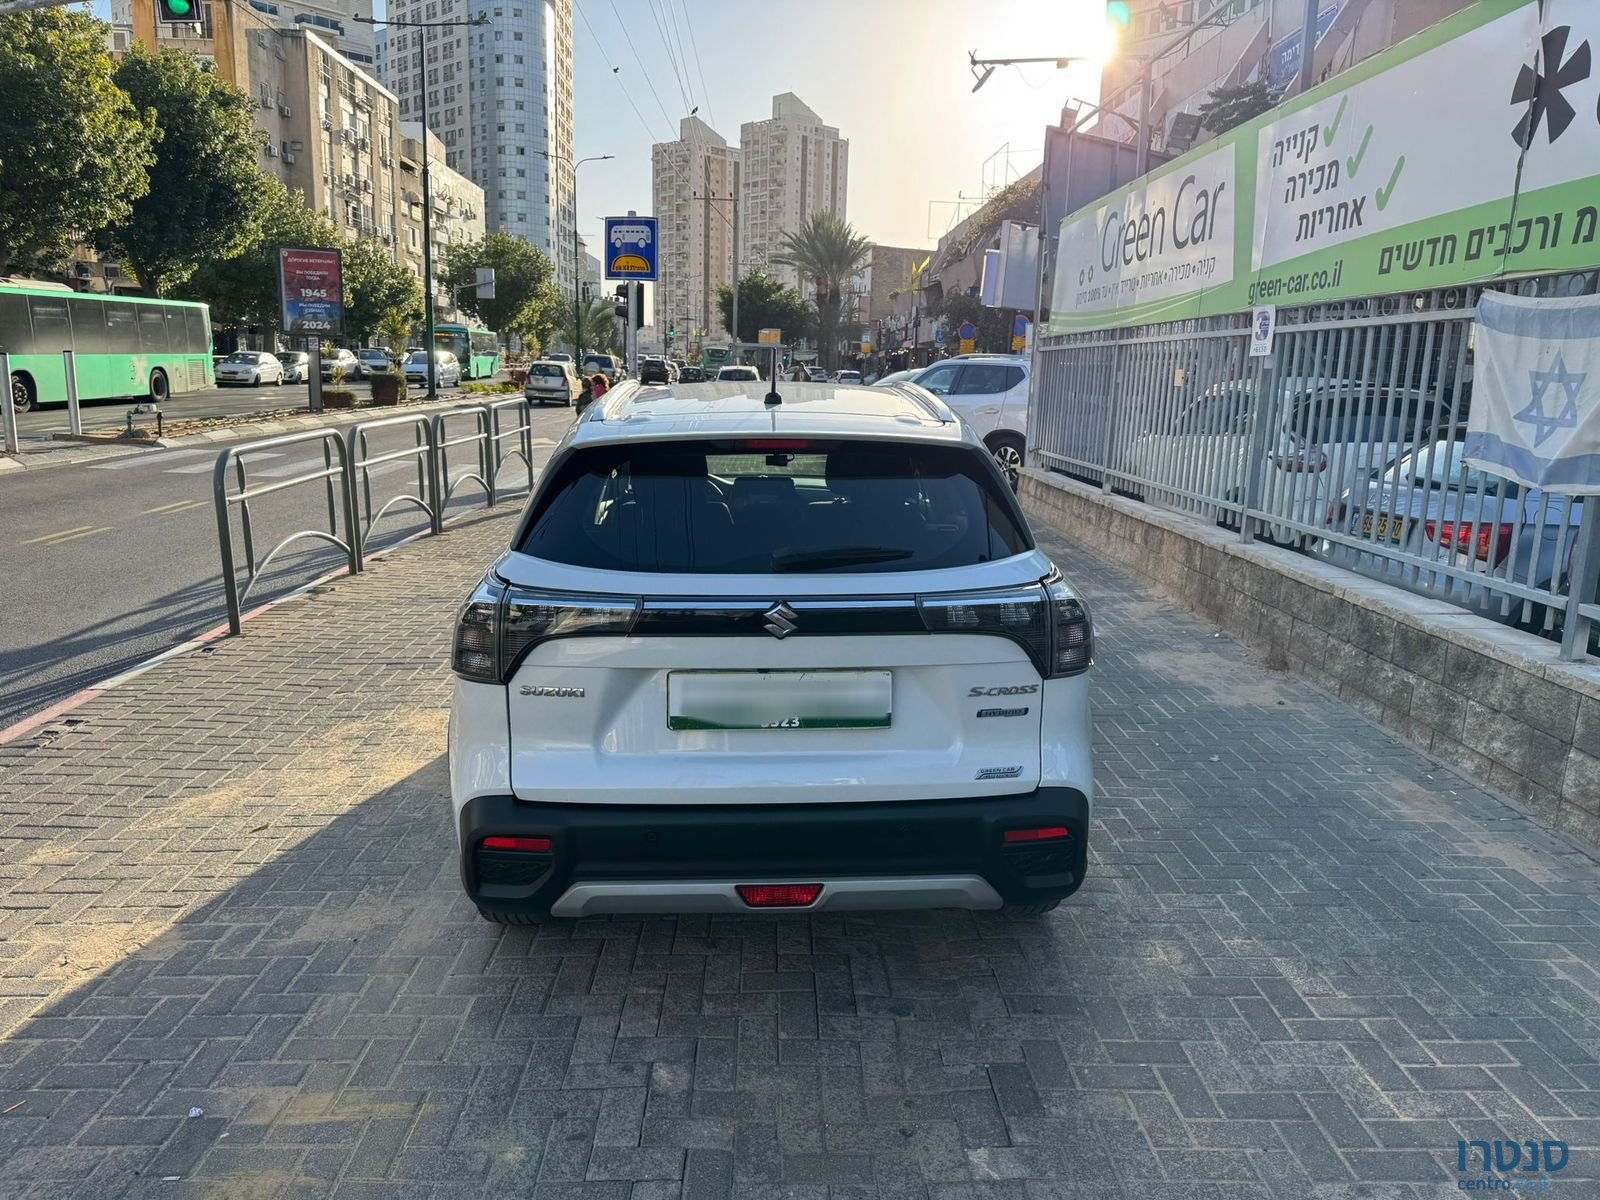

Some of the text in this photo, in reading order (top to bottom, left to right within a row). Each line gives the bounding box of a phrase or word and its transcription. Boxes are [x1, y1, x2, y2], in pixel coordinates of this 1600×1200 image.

[1272, 124, 1319, 168] קנייה
[1284, 159, 1340, 203] מכירה
[1102, 174, 1225, 272] Green Car
[1295, 195, 1367, 242] אחריות
[1464, 212, 1563, 262] ורכבים
[1377, 234, 1457, 275] חדשים
[300, 288, 328, 298] 1945
[1248, 259, 1343, 305] green-car.co.il
[303, 321, 331, 330] 2024
[519, 685, 585, 698] SUZUKI
